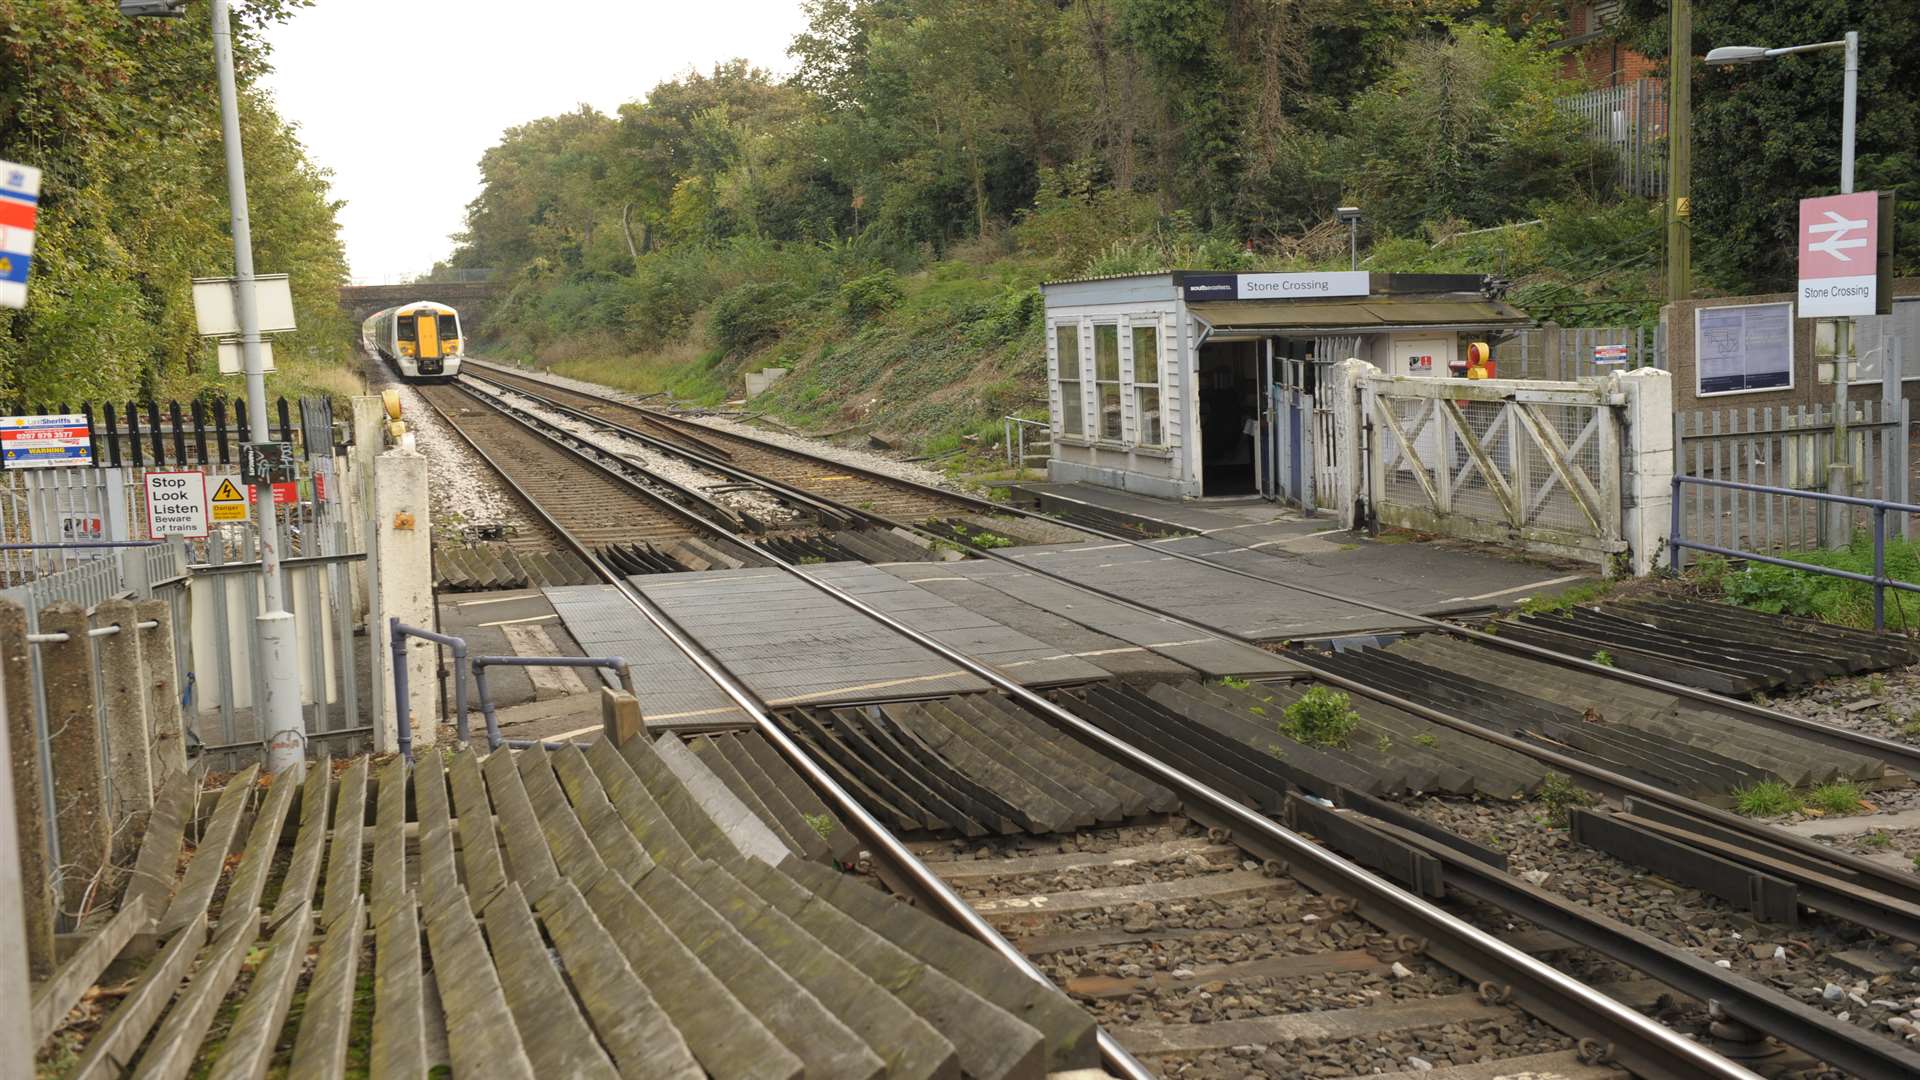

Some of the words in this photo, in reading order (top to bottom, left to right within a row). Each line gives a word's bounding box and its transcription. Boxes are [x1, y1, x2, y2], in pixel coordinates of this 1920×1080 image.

[1247, 281, 1280, 292] Stone
[1282, 280, 1329, 292] Crossing
[1804, 287, 1829, 298] Stone
[1831, 285, 1869, 298] Crossing
[152, 477, 186, 488] Stop
[153, 490, 188, 501] Look
[154, 504, 198, 514] Listen
[155, 515, 192, 523] Beware
[169, 523, 198, 531] trains
